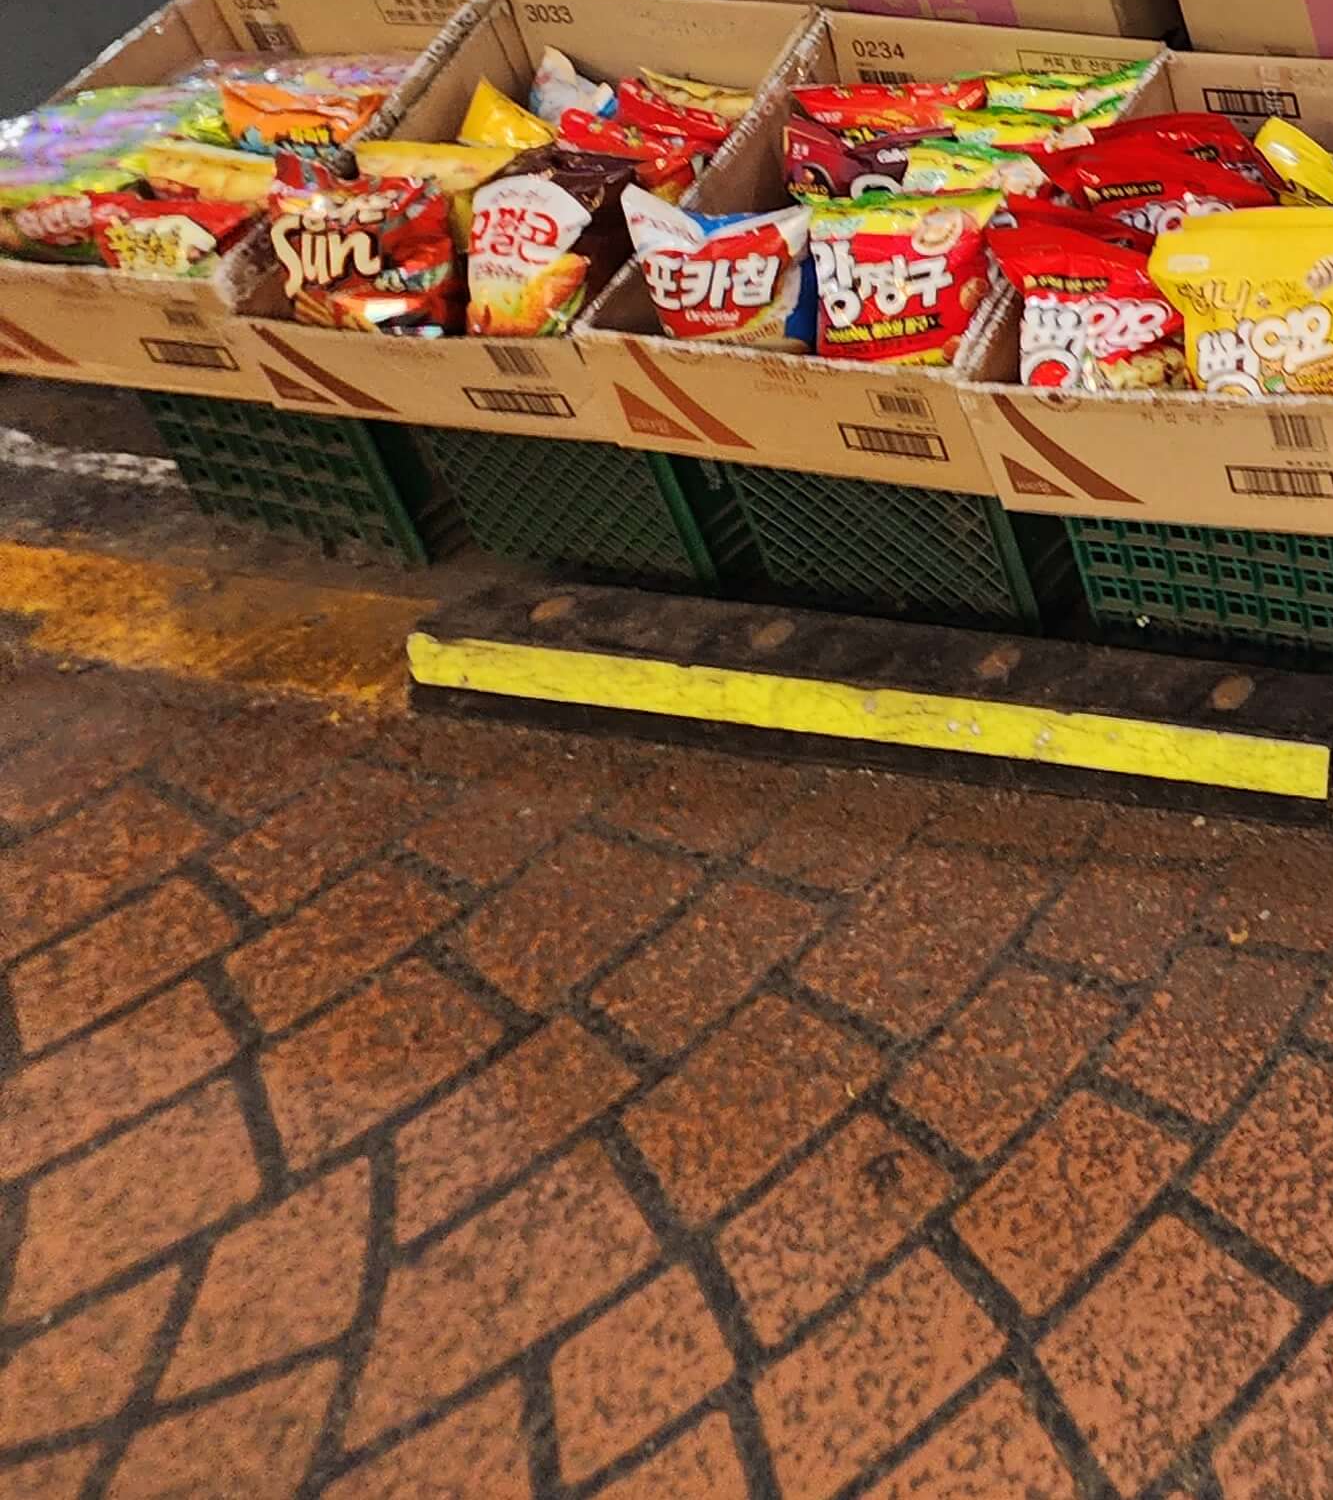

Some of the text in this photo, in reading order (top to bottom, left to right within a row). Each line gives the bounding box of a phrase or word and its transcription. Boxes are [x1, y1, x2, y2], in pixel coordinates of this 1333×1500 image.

[525, 2, 573, 26] 3033
[852, 37, 904, 60] 0234
[270, 214, 380, 297] Sun
[643, 252, 779, 312] 포카칩
